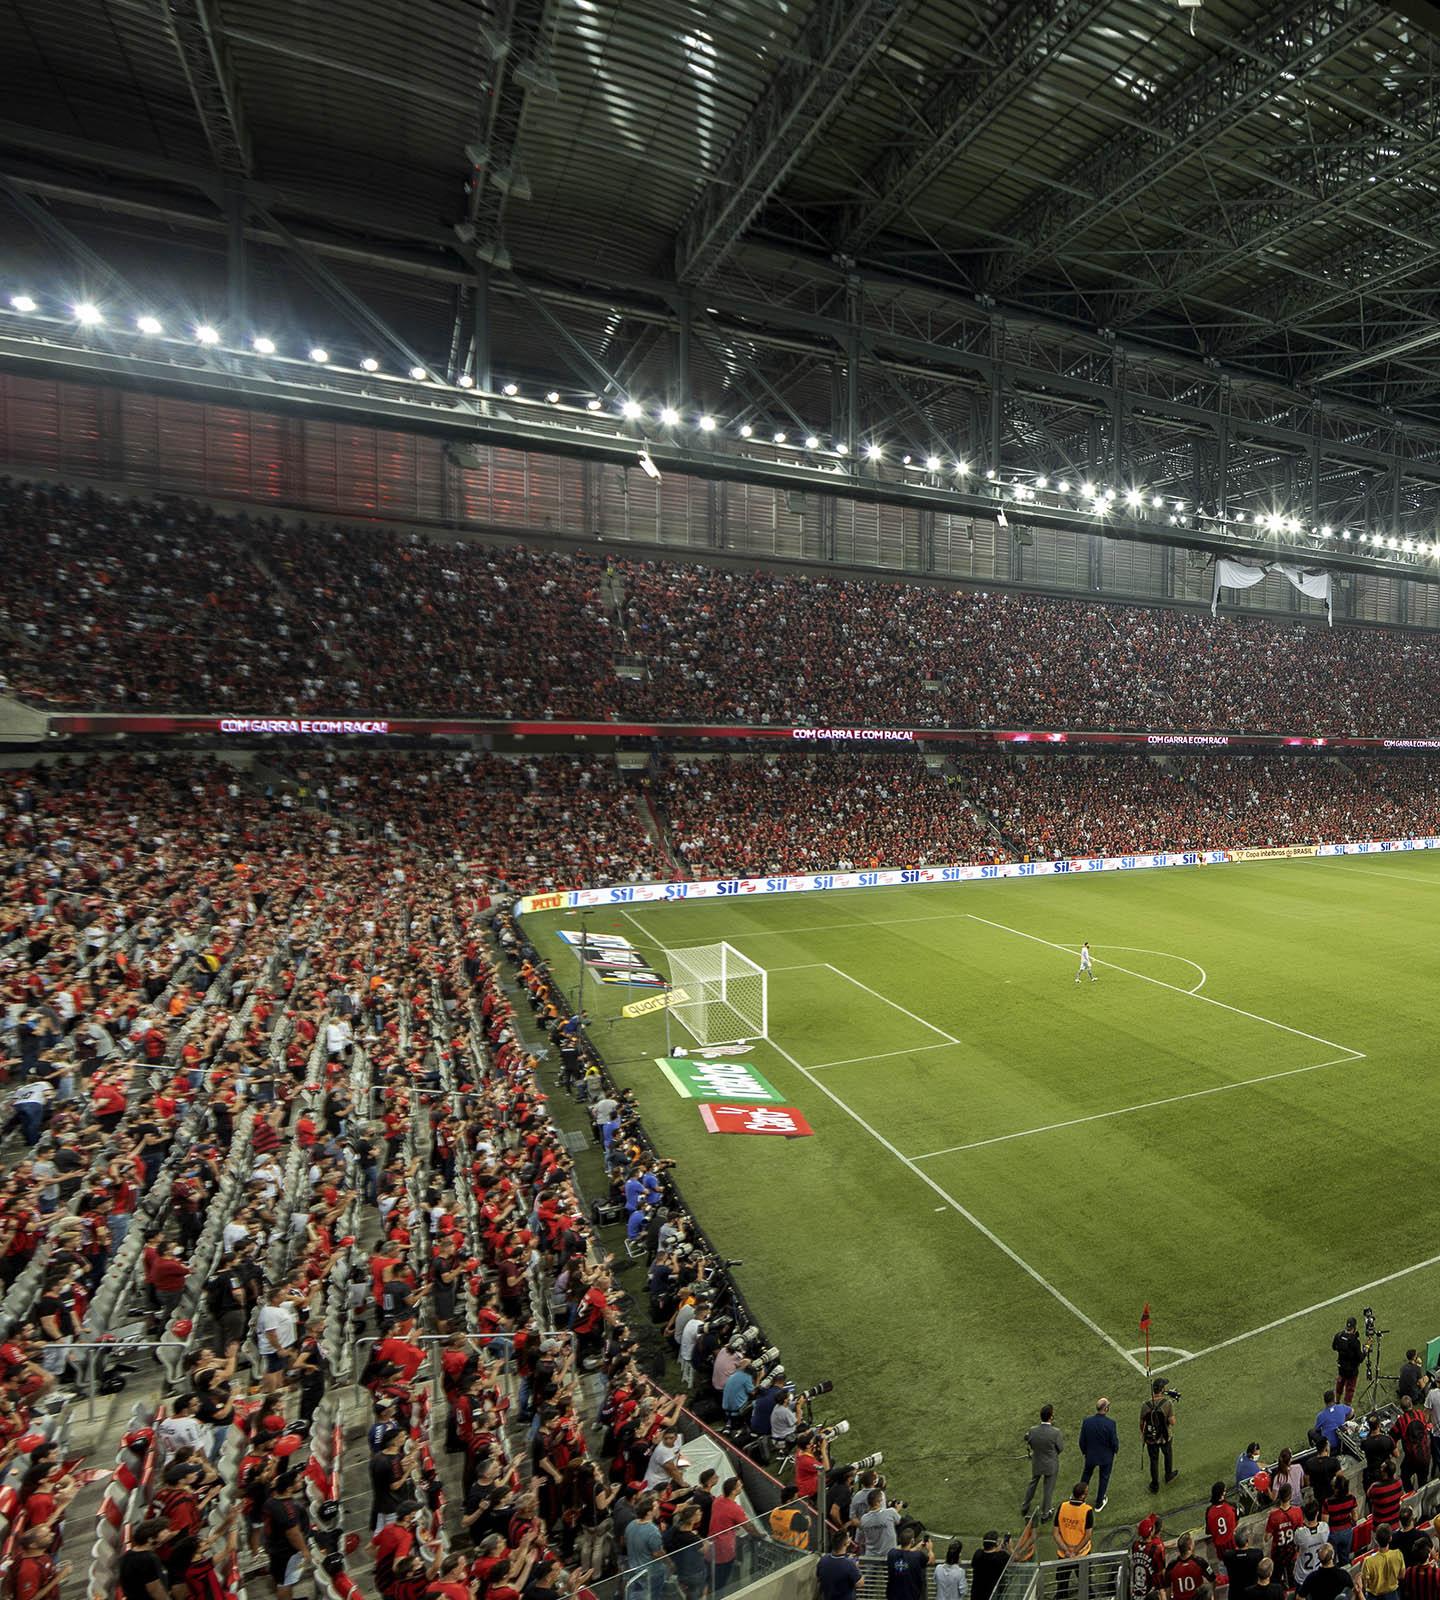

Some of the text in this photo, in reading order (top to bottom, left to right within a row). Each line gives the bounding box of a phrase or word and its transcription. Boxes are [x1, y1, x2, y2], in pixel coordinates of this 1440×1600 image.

[221, 720, 249, 732] COM
[250, 720, 300, 733] GARRA
[312, 721, 343, 733] COM
[793, 729, 816, 739] COM
[817, 730, 853, 739] GARRA
[862, 731, 884, 739] COM
[1148, 736, 1164, 744] COM
[1164, 736, 1188, 744] GARRA
[1335, 845, 1345, 854] Sil
[1358, 844, 1368, 853] Sil
[1381, 842, 1391, 851] Sil
[1403, 840, 1413, 849] Sil
[1424, 839, 1434, 848] Sil
[1183, 853, 1196, 864] Sil
[1212, 851, 1224, 862] Sil
[1245, 851, 1260, 859] Copa
[1293, 847, 1313, 855] BRASIL
[1088, 859, 1103, 870] Sil
[1121, 857, 1135, 868] Sil
[1152, 855, 1167, 866] Sil
[981, 866, 998, 877] Sil
[1018, 863, 1035, 875] Sil
[1054, 861, 1070, 873] Sil
[859, 873, 878, 886] Sil
[901, 871, 919, 883] Sil
[942, 868, 960, 880] Sil
[717, 882, 739, 894] Sil
[767, 879, 787, 892] Sil
[813, 876, 833, 888] Sil
[611, 888, 634, 902] Sil
[665, 884, 688, 898] Sil
[1217, 1517, 1227, 1535] 9
[1278, 1531, 1294, 1547] 39
[1178, 1576, 1195, 1594] 10
